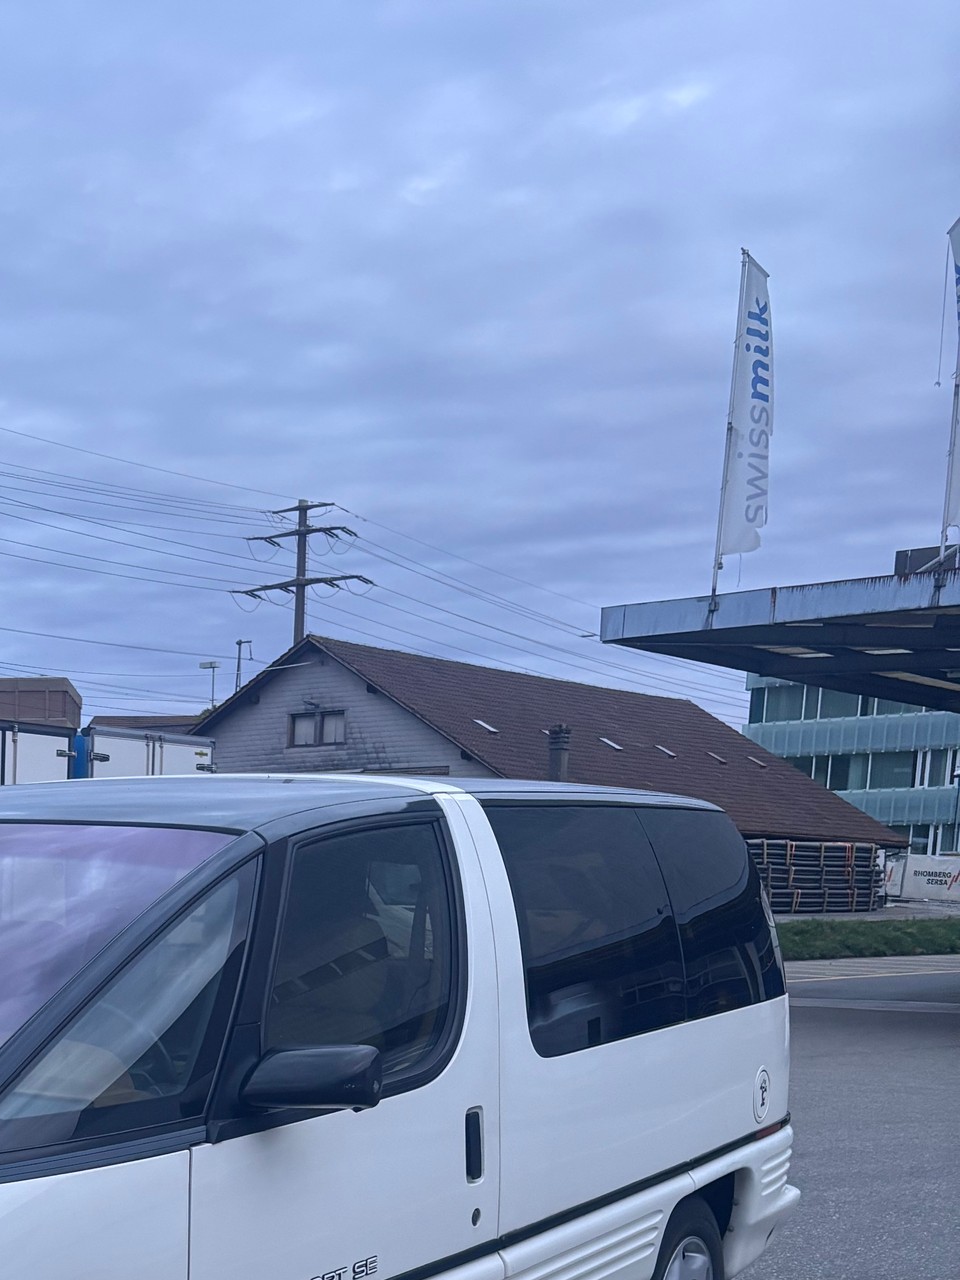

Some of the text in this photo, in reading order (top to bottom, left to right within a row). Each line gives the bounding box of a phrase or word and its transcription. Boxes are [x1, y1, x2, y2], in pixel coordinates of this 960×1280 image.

[737, 297, 770, 525] swissmilk
[913, 870, 952, 878] RHOMBERG
[352, 1255, 378, 1280] SE
